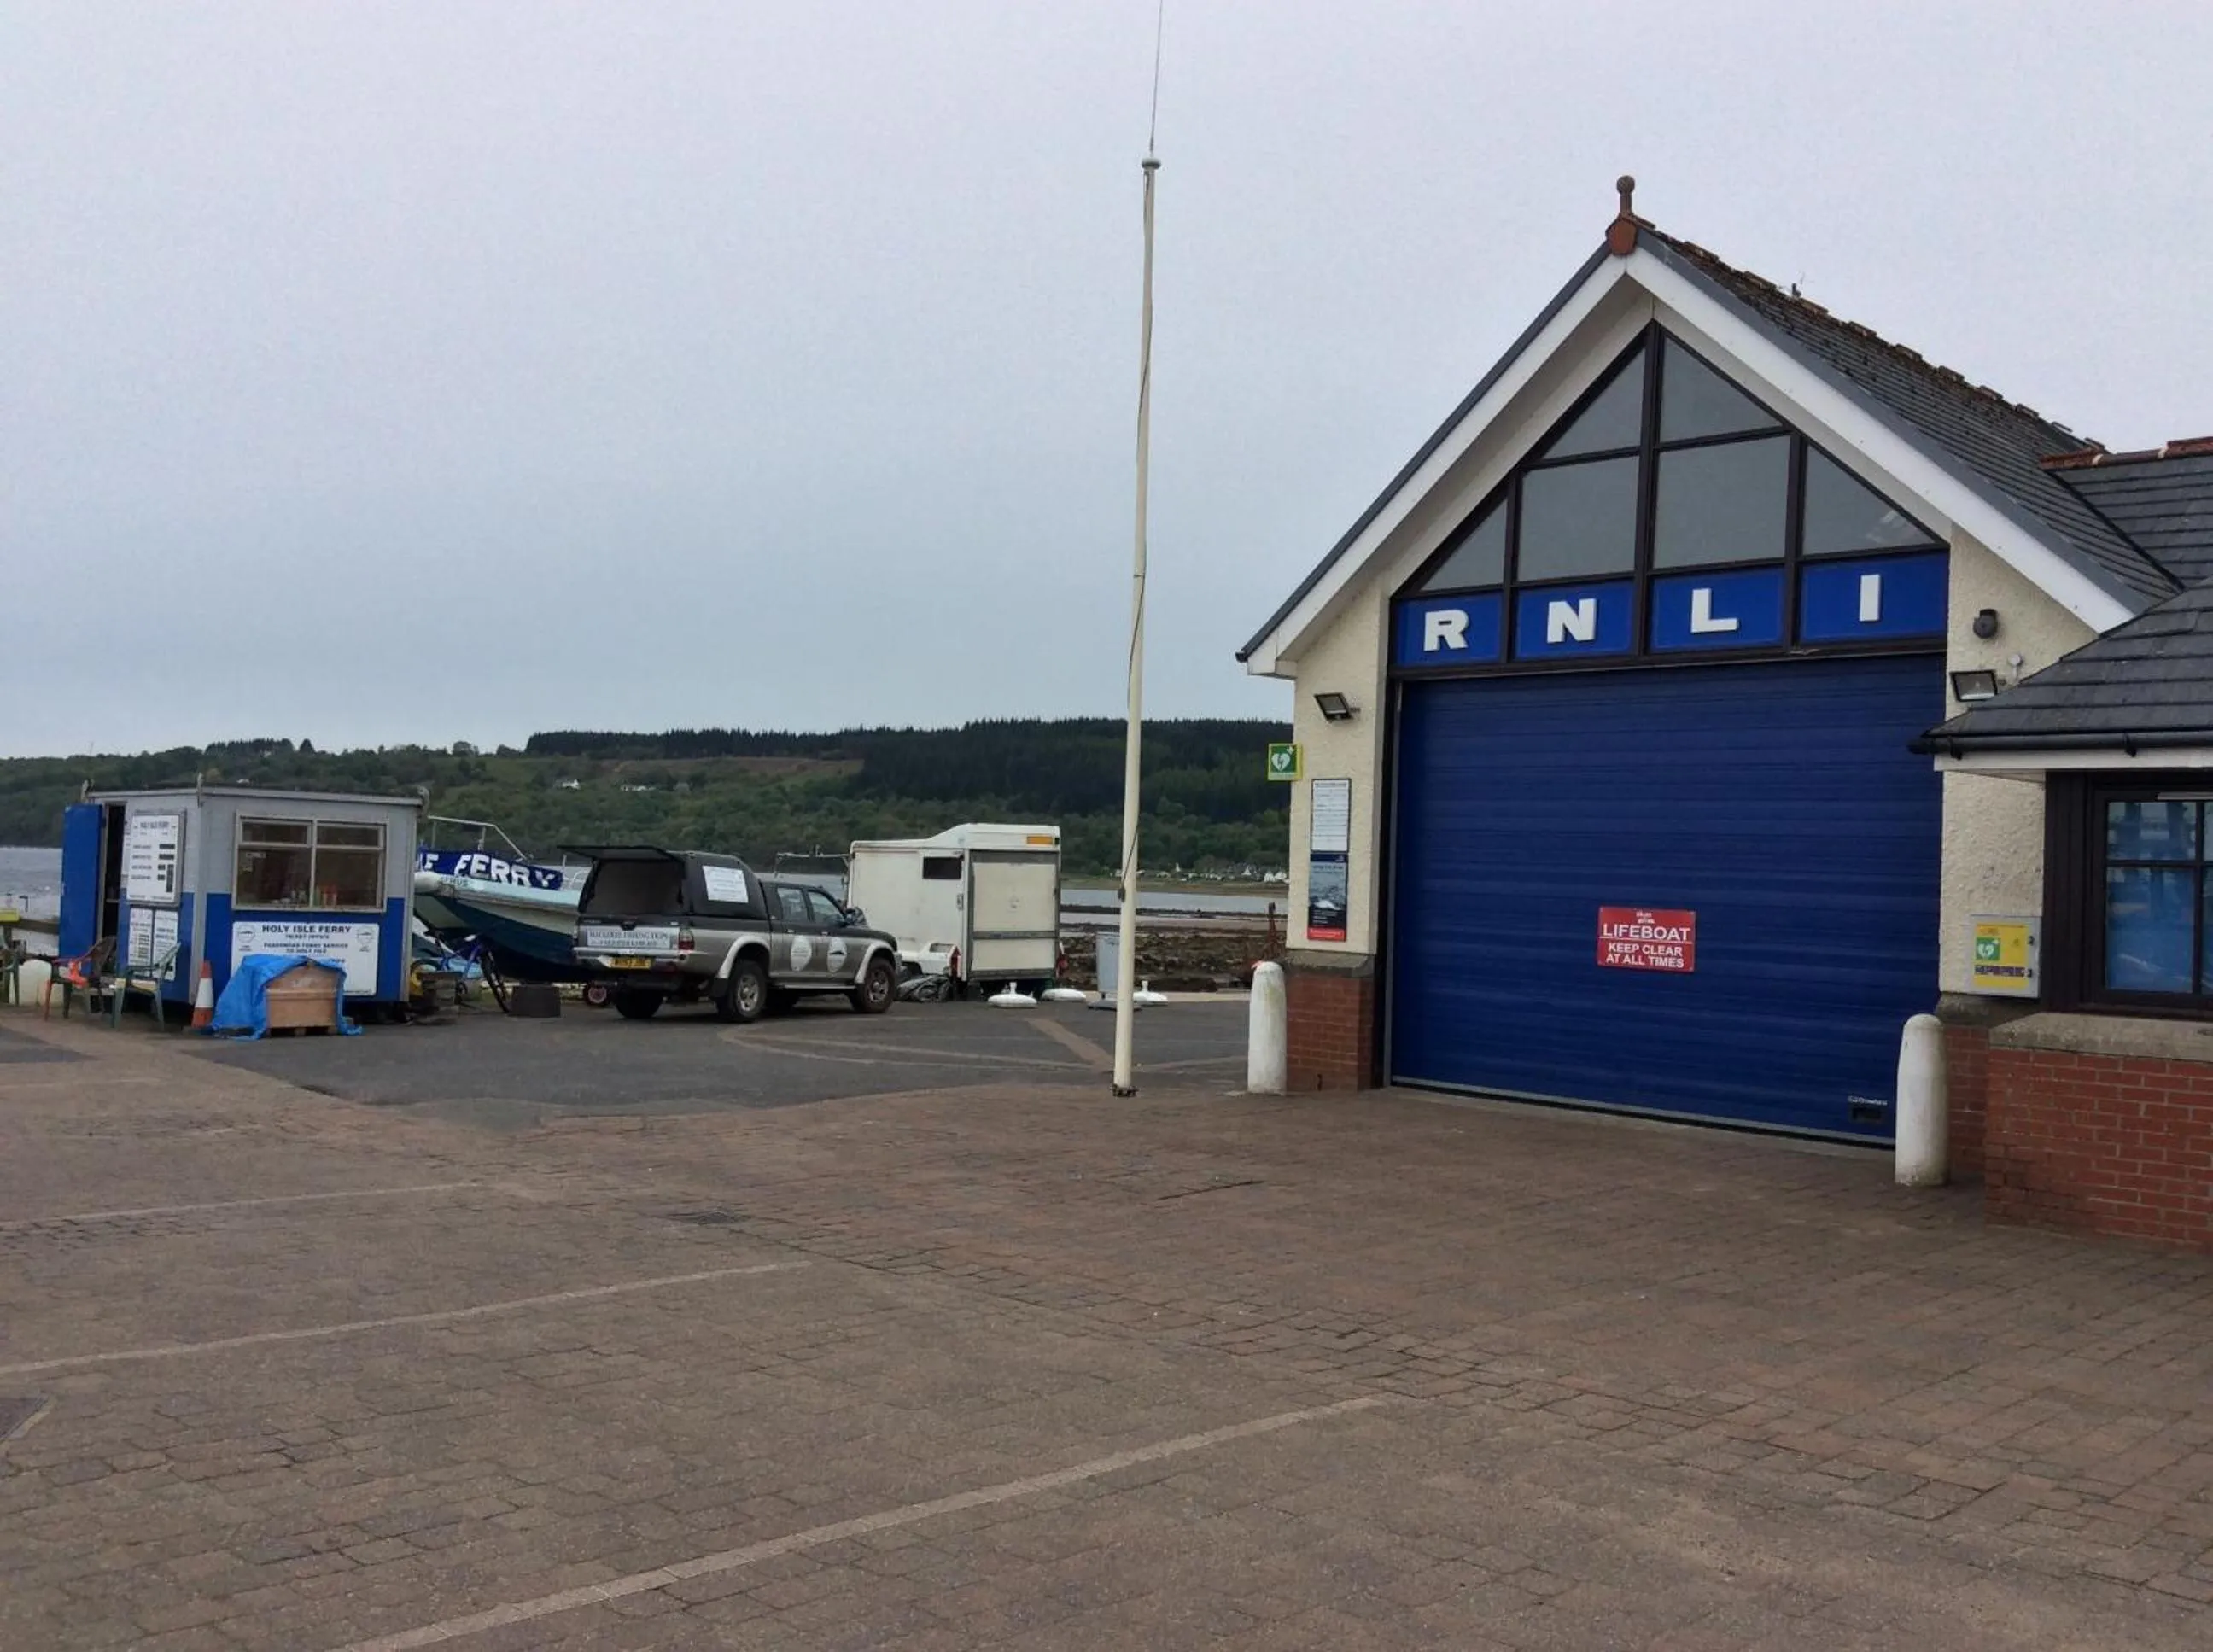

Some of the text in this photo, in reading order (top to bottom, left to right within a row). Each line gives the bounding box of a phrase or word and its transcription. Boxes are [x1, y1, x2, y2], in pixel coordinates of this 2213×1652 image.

[453, 853, 555, 888] FERRY
[261, 925, 352, 933] HOLY ISLE FERRY
[1603, 923, 1691, 941] LIFEBOAT
[1609, 942, 1683, 956] KEEP CLEAR
[1606, 953, 1684, 968] AT ALL TIMES
